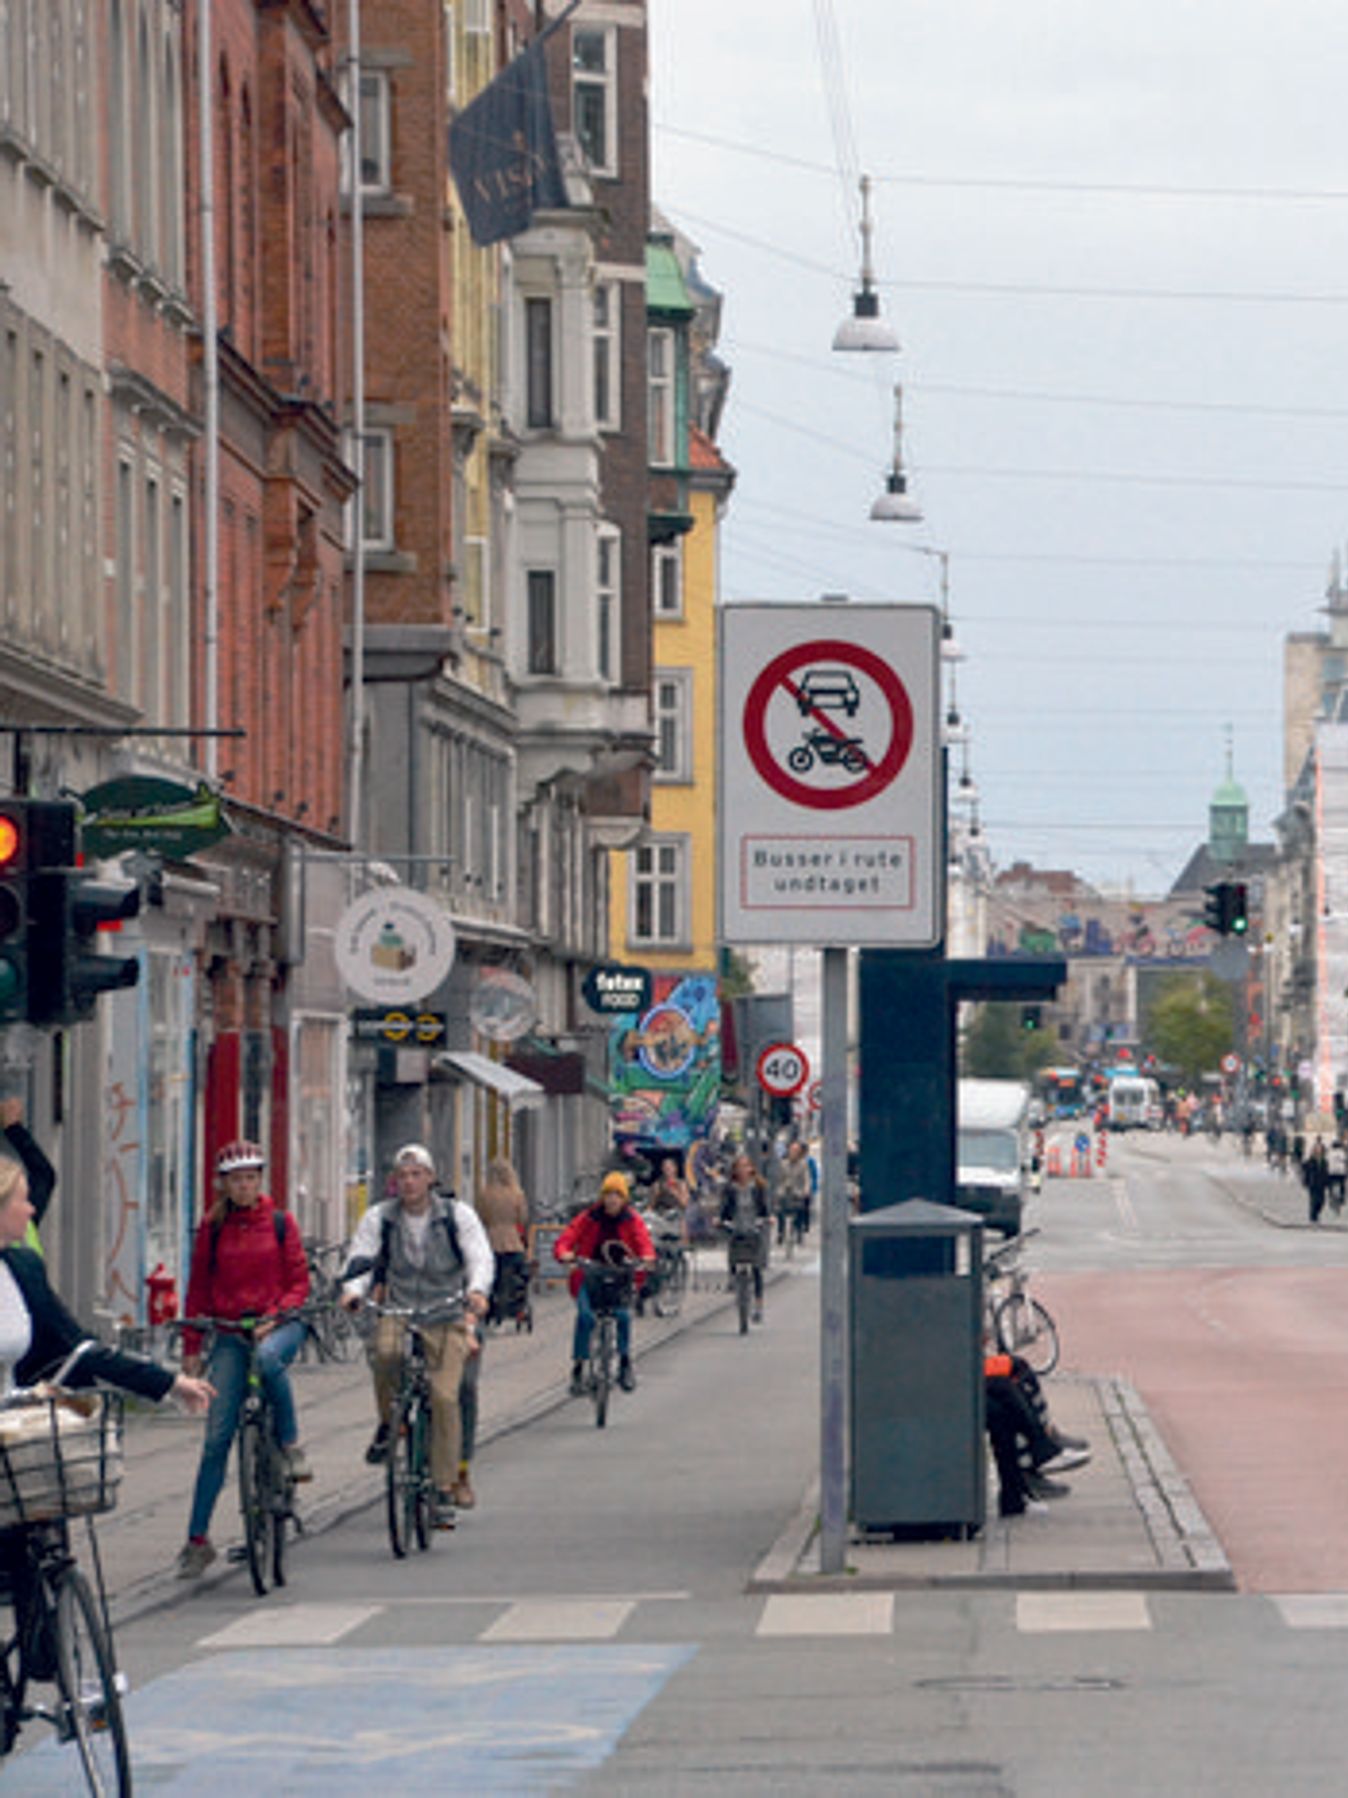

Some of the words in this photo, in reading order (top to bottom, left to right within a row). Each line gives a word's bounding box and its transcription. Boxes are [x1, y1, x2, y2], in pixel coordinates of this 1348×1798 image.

[753, 850, 833, 868] Busser
[854, 851, 903, 868] rute
[774, 874, 881, 894] undtaget
[766, 1058, 799, 1081] 40
